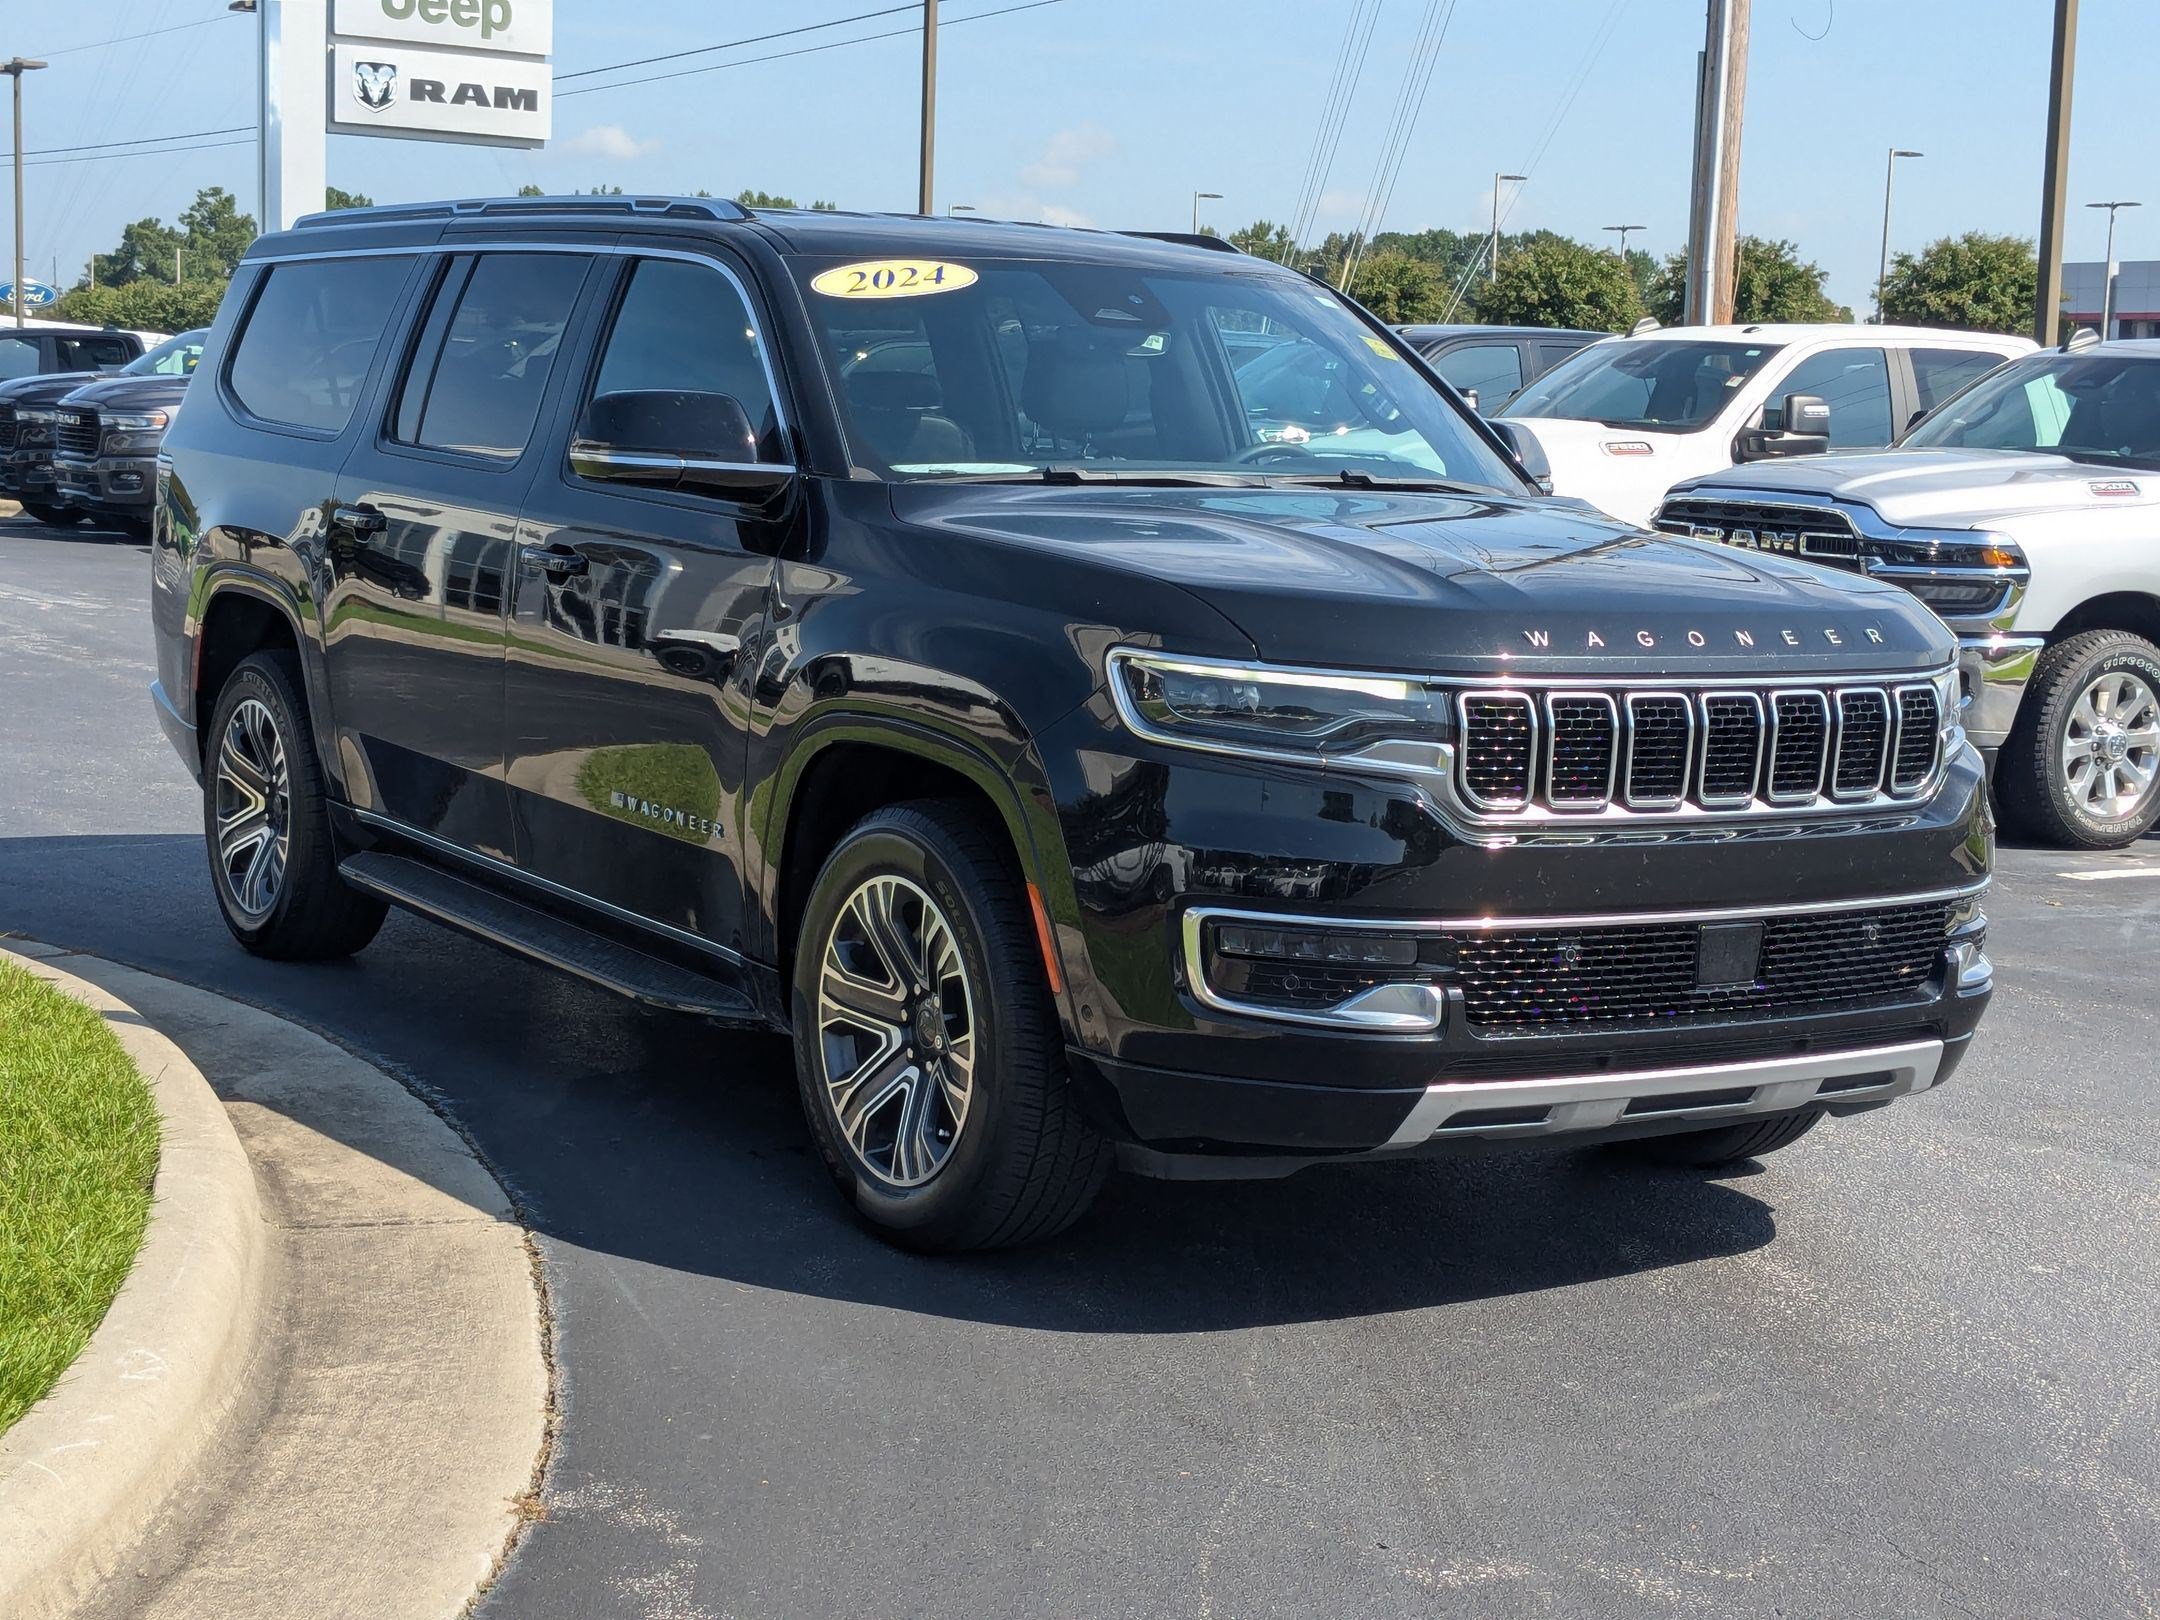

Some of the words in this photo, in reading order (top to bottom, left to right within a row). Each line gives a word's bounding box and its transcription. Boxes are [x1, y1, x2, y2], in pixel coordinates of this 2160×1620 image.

[410, 78, 538, 112] RAM
[7, 286, 46, 302] Frd
[846, 265, 946, 293] 2024
[1521, 628, 1884, 649] WAGONEER
[2103, 652, 2160, 684] Firesto
[627, 795, 724, 839] WAGONEER
